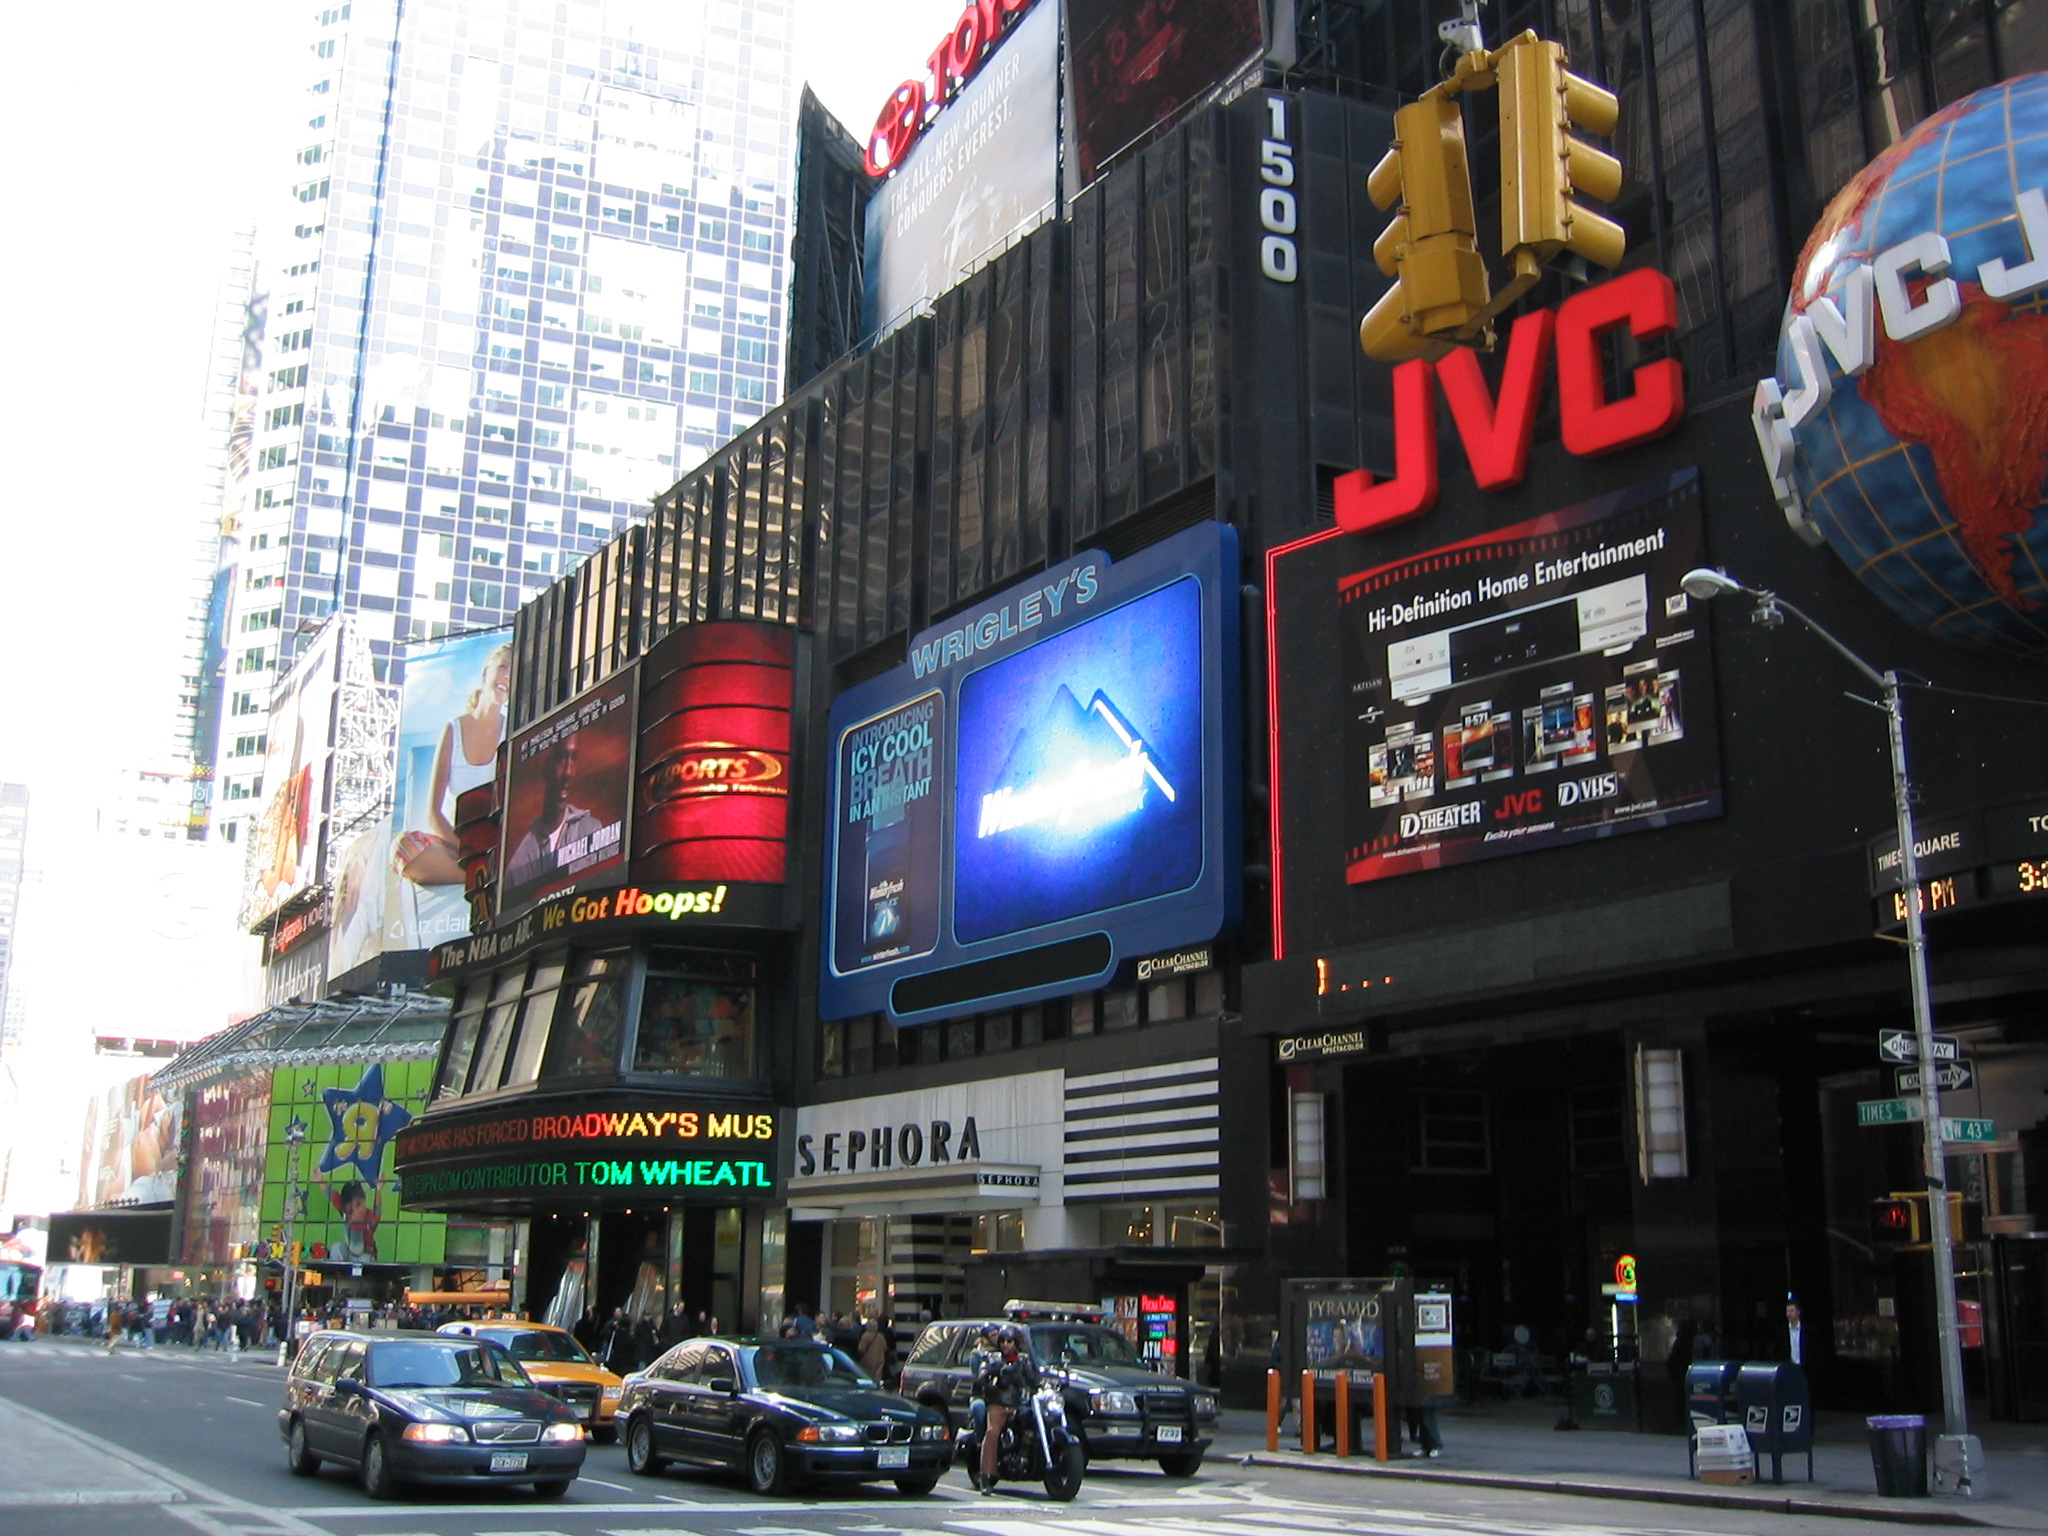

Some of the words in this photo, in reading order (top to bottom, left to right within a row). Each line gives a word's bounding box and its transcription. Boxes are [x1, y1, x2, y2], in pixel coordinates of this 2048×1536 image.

[890, 183, 910, 216] THE
[912, 130, 960, 190] ALL-NEW
[964, 53, 1021, 133] 4RUNNER
[896, 167, 954, 238] CONQUERS
[957, 96, 1013, 171] EVEREST.
[1260, 97, 1299, 283] 1500
[1781, 231, 1961, 429] JVC
[1333, 267, 1684, 534] JVC
[1368, 588, 1472, 633] Hi-Definition
[1479, 574, 1529, 602] Home
[1535, 527, 1666, 585] Entertainment
[911, 564, 1099, 680] WRIGLEY'S
[851, 701, 935, 750] INTRODUCING
[850, 741, 879, 777] ICY
[881, 720, 933, 762] COOL
[850, 744, 934, 806] BREATH
[848, 803, 861, 823] IN
[1494, 789, 1543, 819] JVC
[1877, 849, 1903, 872] TIMES
[1912, 831, 1961, 859] QUARE
[1930, 876, 1957, 911] PM
[441, 944, 465, 969] The
[468, 933, 497, 963] NBA
[500, 934, 513, 954] on
[543, 904, 566, 931] We
[571, 895, 608, 924] Got
[615, 884, 728, 921] Hoops!
[1941, 1070, 1963, 1084] WAY
[454, 1125, 476, 1148] HAS
[477, 1118, 528, 1145] FORCED
[532, 1112, 700, 1141] BROADWAY'S
[707, 1113, 774, 1141] MUS
[1861, 1105, 1893, 1122] TIMES
[1951, 1124, 1962, 1139] W
[1966, 1123, 1982, 1139] 43
[797, 1116, 981, 1176] SEPHORA
[462, 1162, 568, 1190] CONTRIBUTOR
[573, 1160, 634, 1188] TOM
[639, 1160, 773, 1189] WHEATL
[979, 1174, 1040, 1188] SEPHORA
[1308, 1299, 1380, 1319] PYRAMID
[1142, 1340, 1161, 1359] ATM
